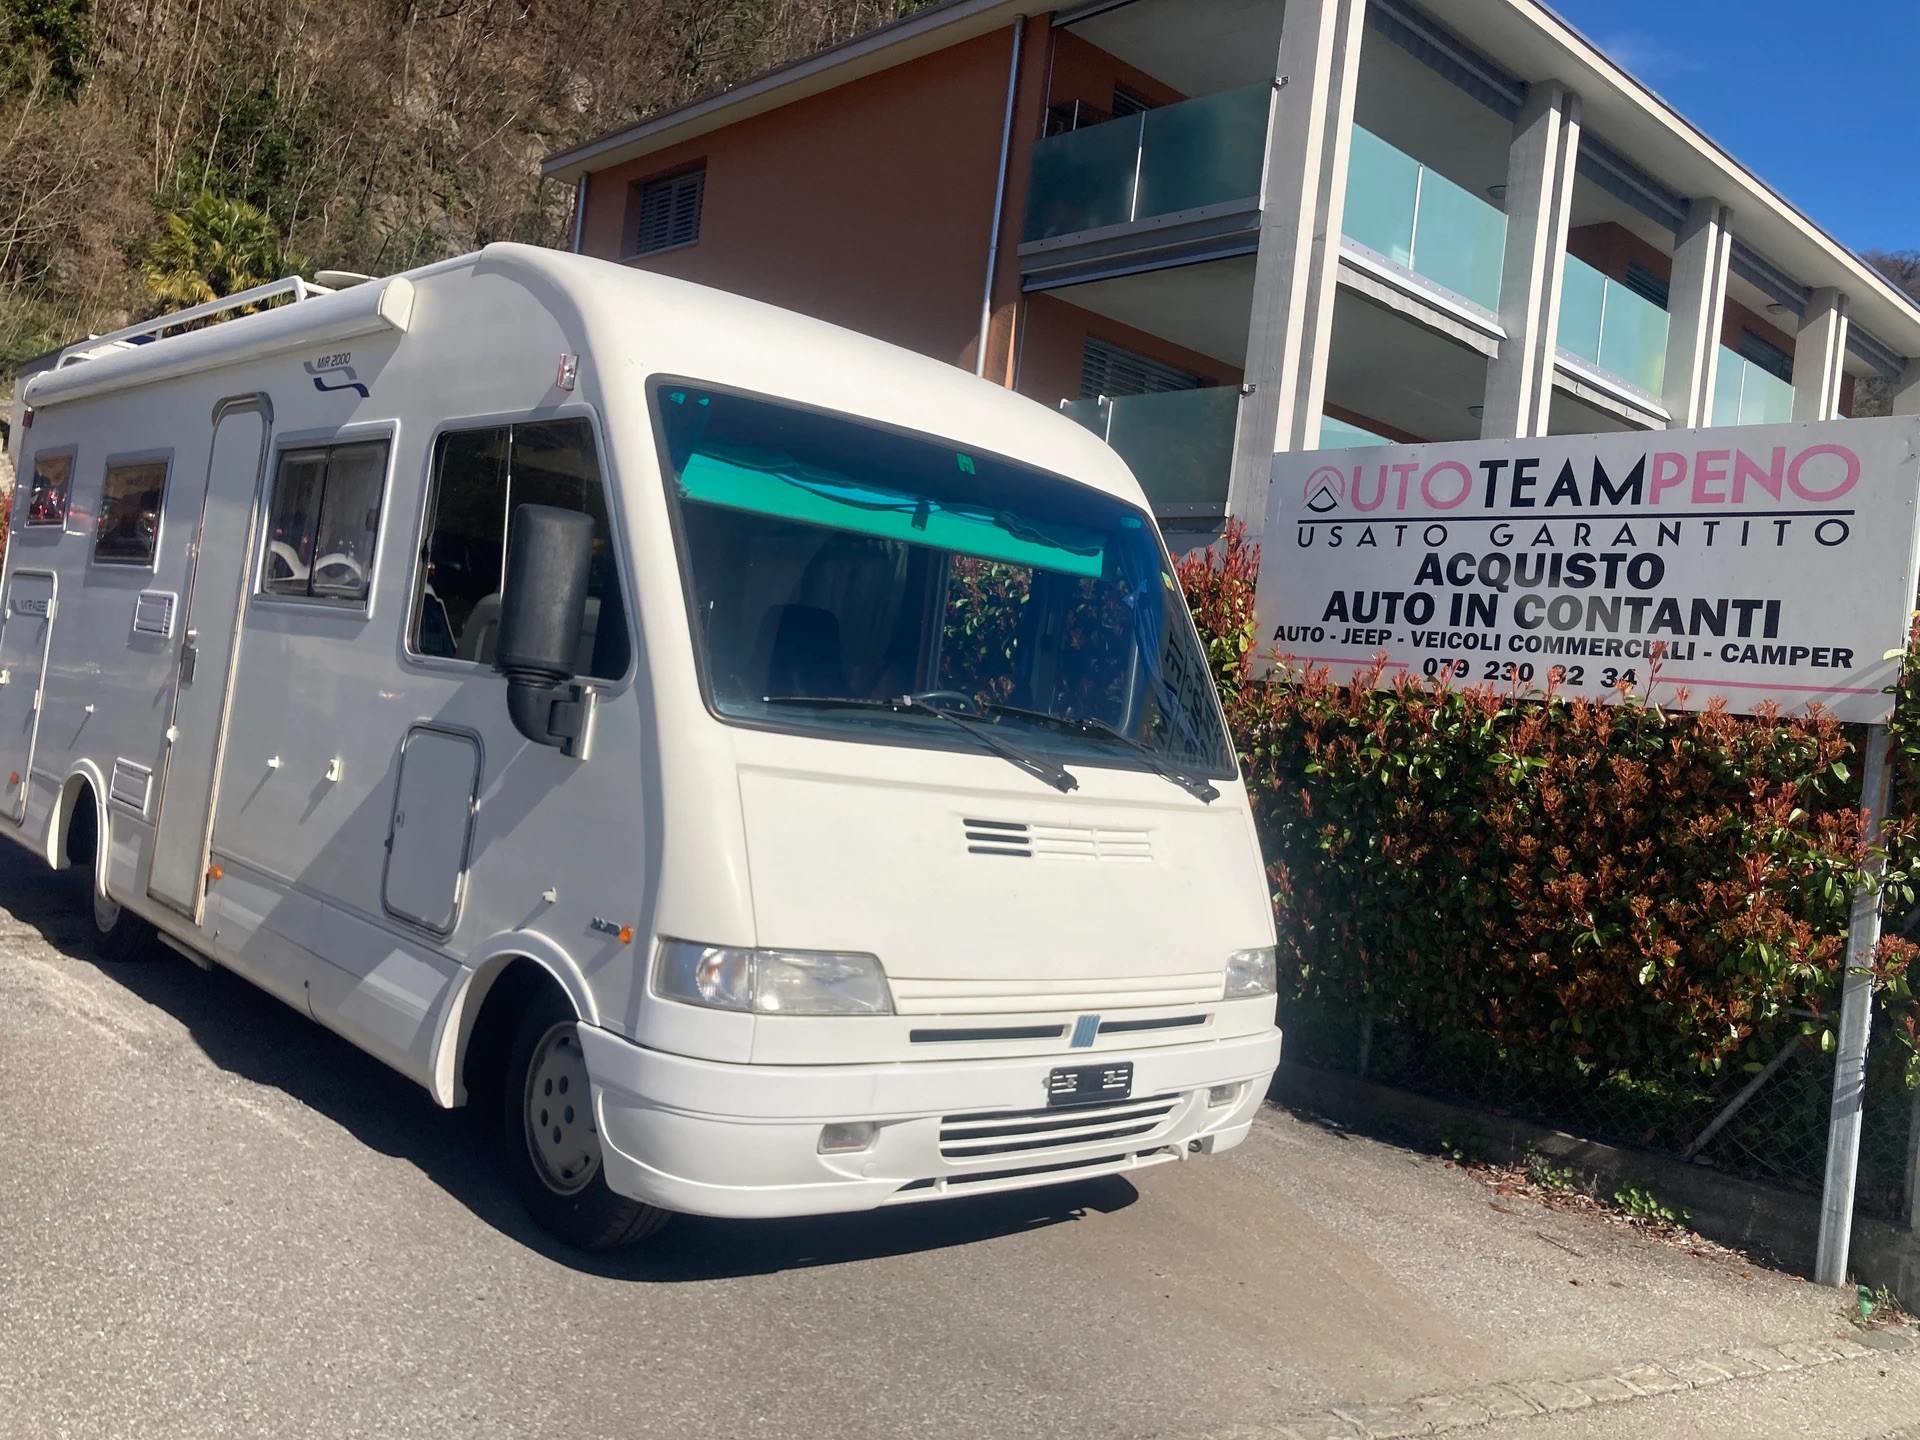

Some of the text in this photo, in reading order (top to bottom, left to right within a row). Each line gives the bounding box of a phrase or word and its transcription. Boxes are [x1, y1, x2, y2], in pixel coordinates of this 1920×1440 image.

[331, 352, 351, 367] 2000
[1297, 518, 1850, 548] USATO GARANTITO
[1413, 552, 1665, 592] ACQUISTO
[1321, 591, 1782, 639] AUTO IN CONTANTI
[1273, 625, 1325, 642] AUTO
[1340, 628, 1392, 645] JEEP
[1410, 630, 1501, 651] VEICOLI
[1720, 643, 1855, 669] CAMPER
[1483, 660, 1535, 682] 230
